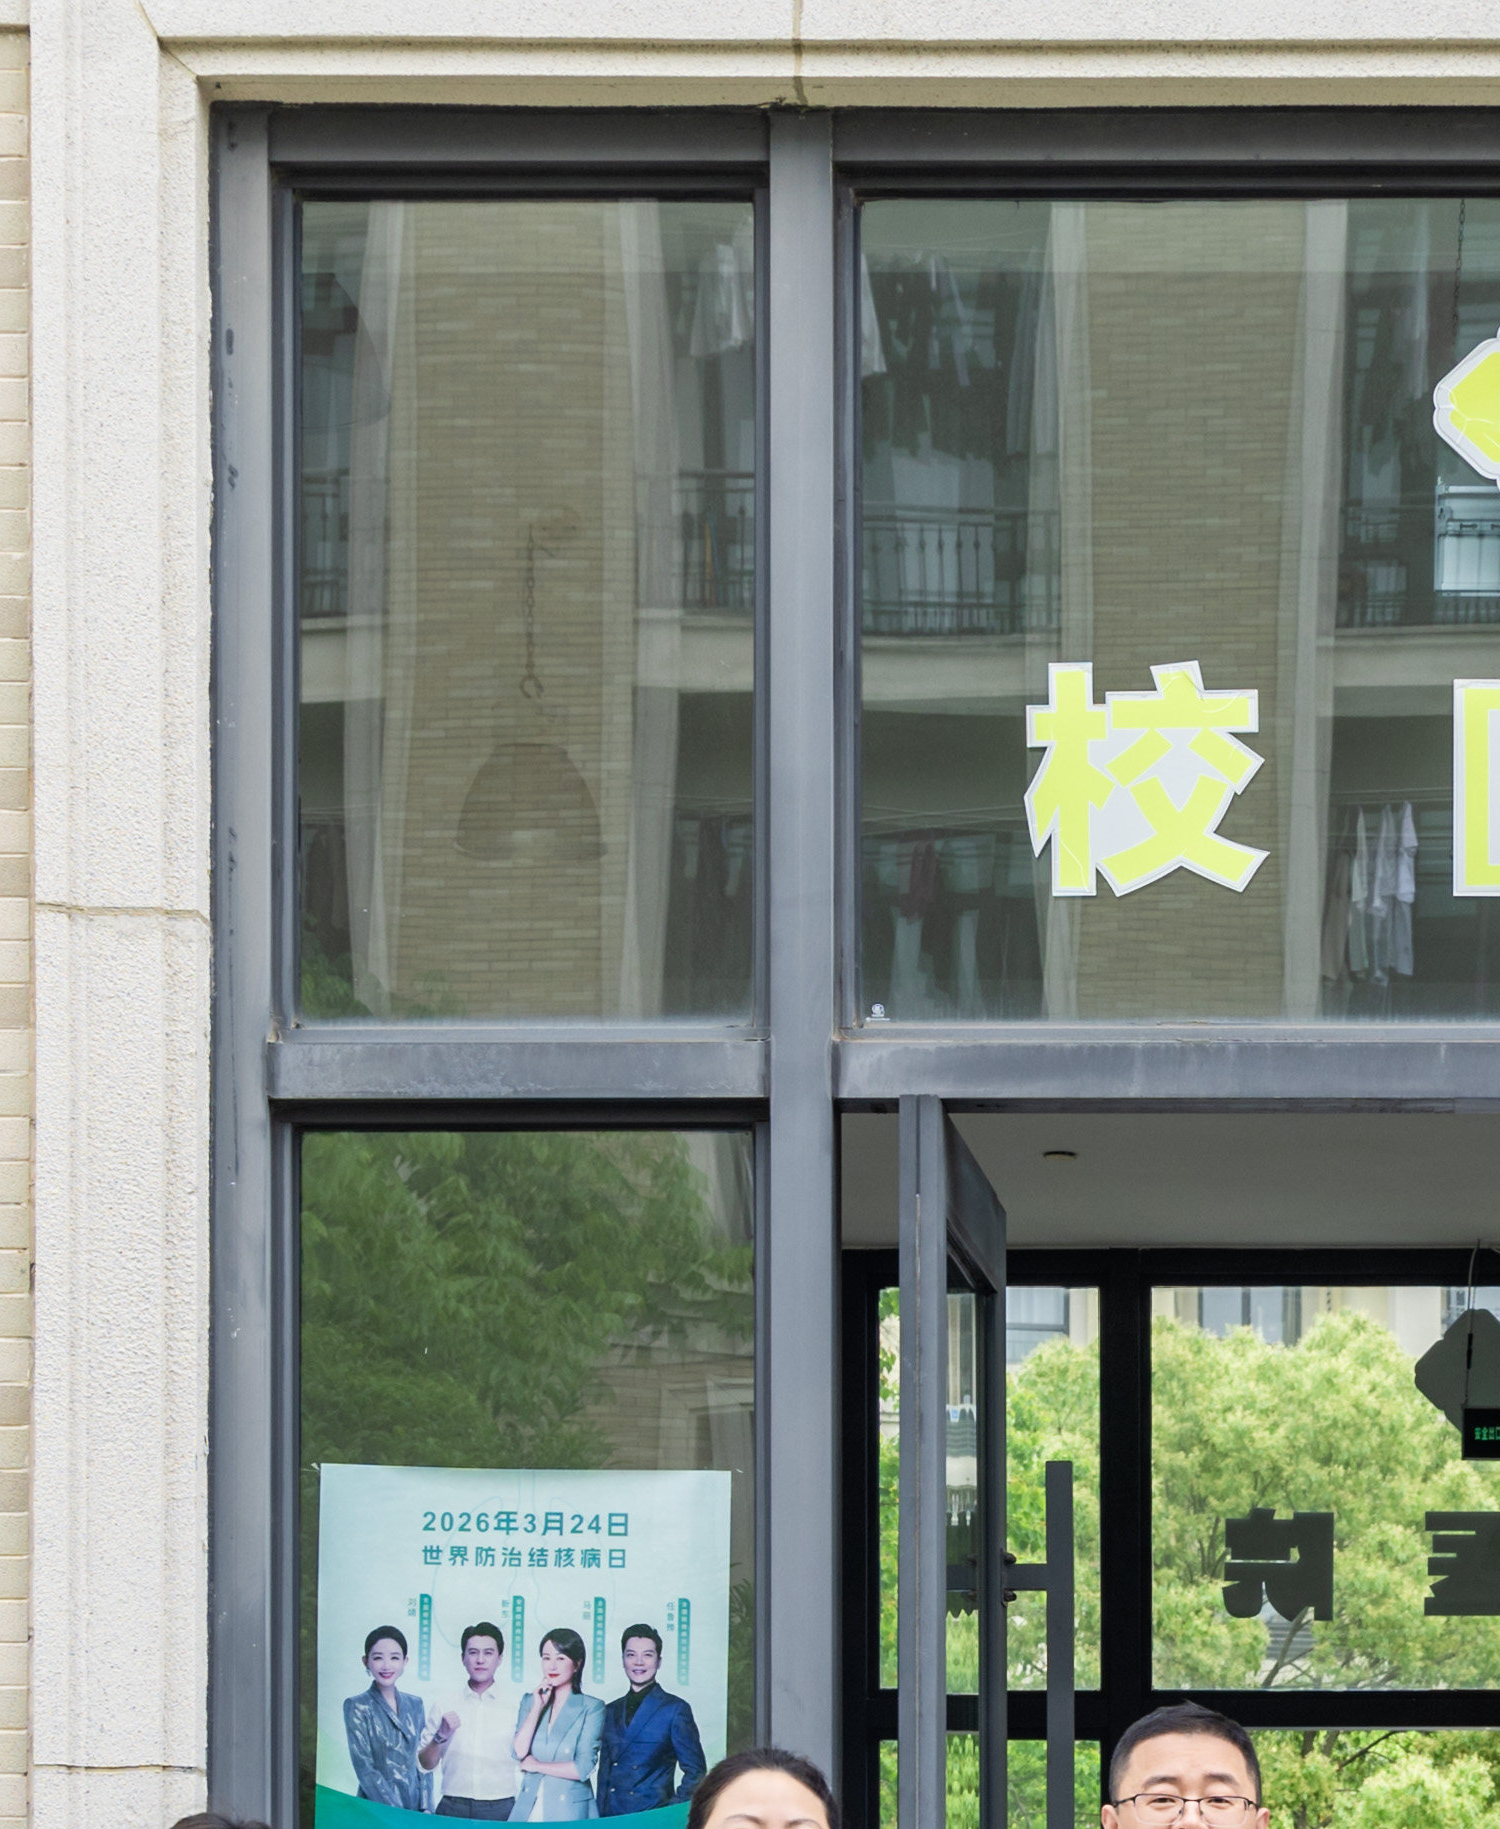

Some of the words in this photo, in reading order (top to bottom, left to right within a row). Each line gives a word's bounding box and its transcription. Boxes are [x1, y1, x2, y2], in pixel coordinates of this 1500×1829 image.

[422, 1510, 629, 1537] 2026年3月24日
[421, 1545, 626, 1568] 世界防治结核病日
